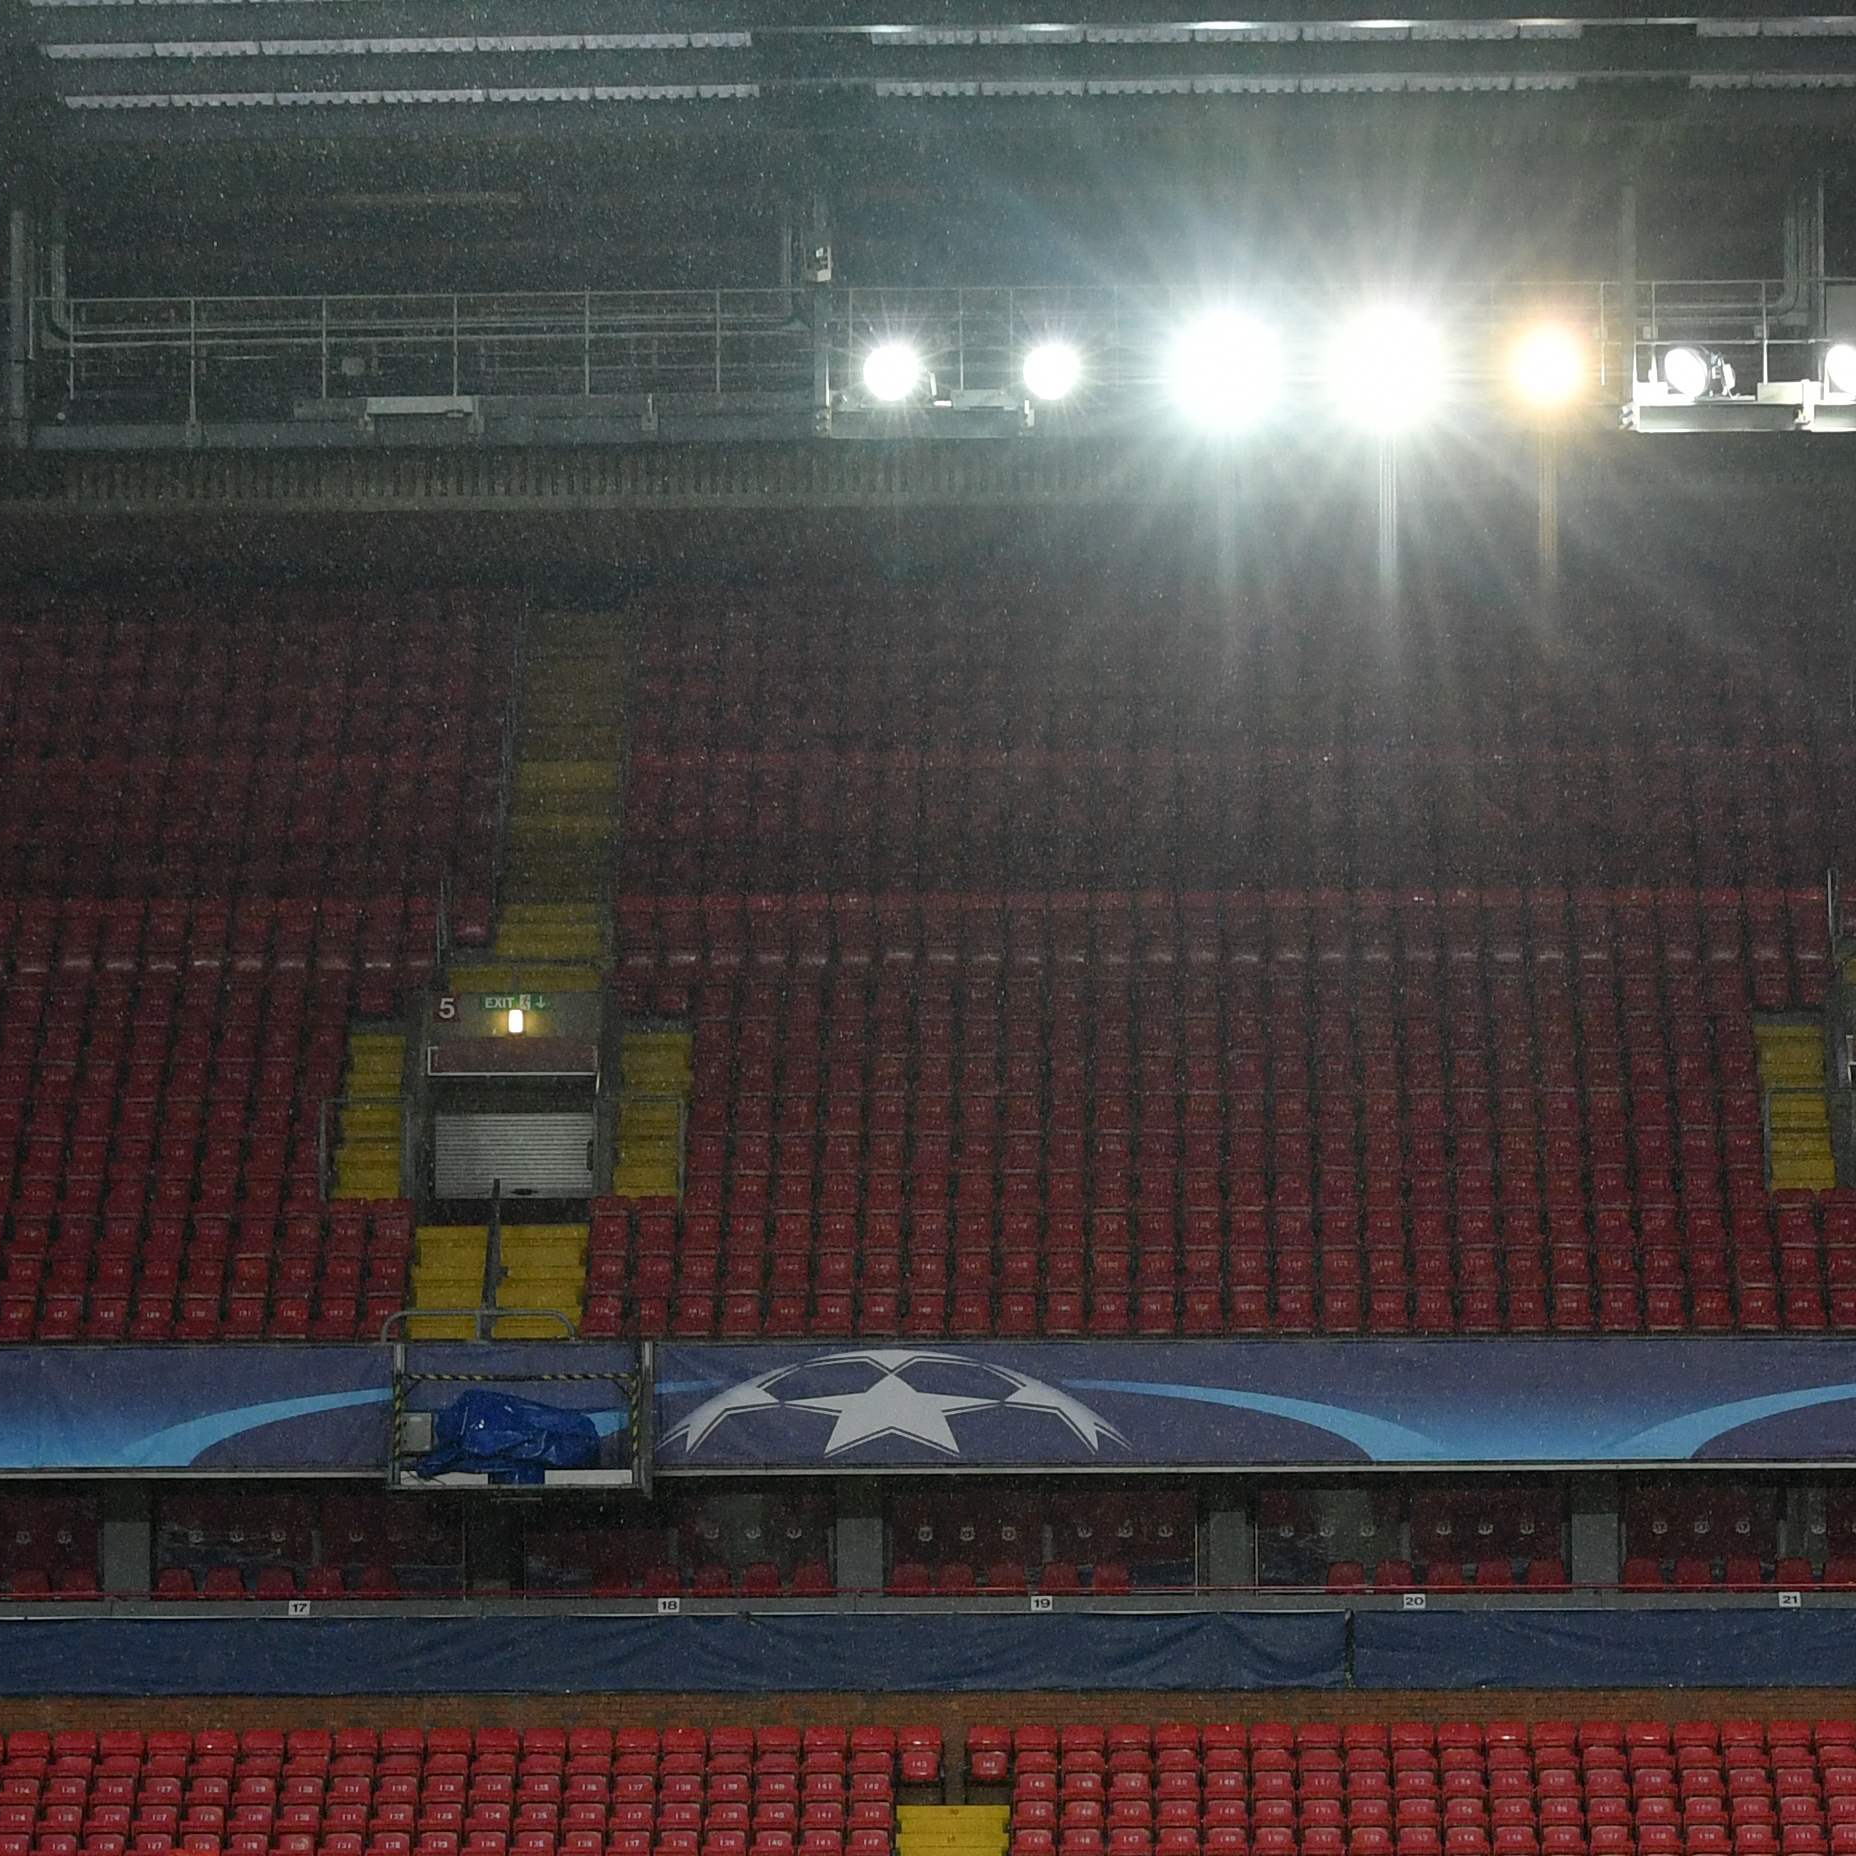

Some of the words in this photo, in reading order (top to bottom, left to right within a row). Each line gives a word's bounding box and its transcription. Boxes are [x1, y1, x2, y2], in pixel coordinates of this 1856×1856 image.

[485, 997, 515, 1009] EXIT
[439, 998, 455, 1018] 5
[1034, 1599, 1051, 1608] 19
[1405, 1597, 1424, 1606] 20
[1782, 1595, 1798, 1604] 21
[291, 1604, 307, 1613] 17
[661, 1601, 678, 1610] 18
